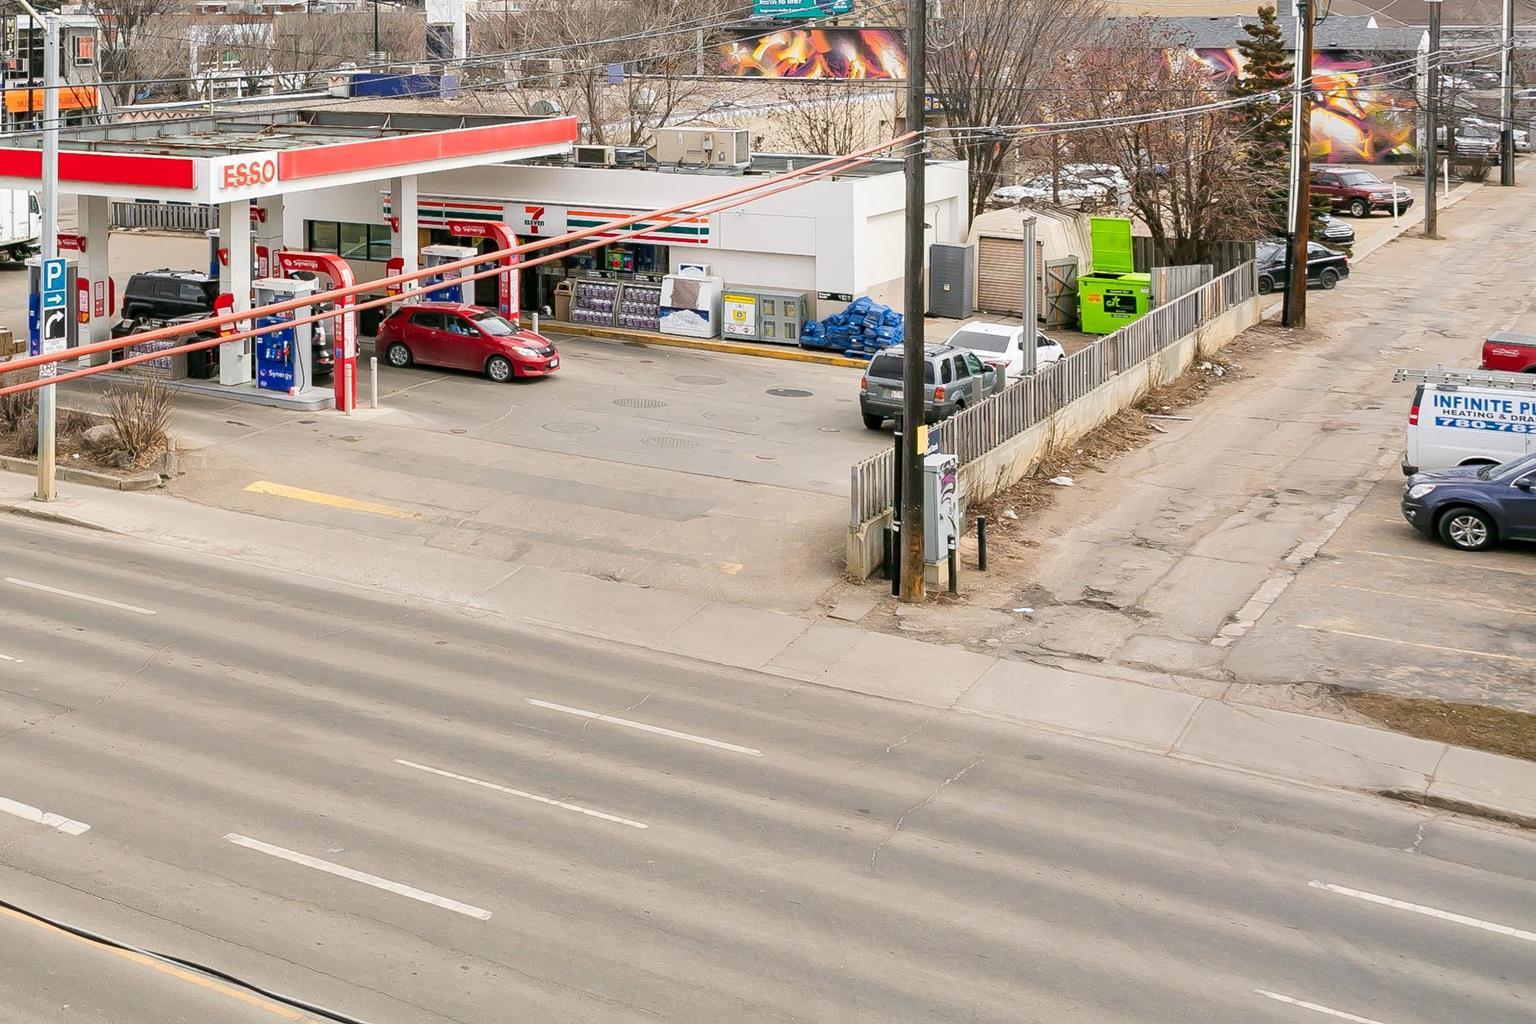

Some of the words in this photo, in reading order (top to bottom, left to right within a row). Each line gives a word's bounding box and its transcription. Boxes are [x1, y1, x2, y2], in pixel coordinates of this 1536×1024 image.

[6, 18, 14, 58] MUSIC
[223, 159, 275, 189] ESSO
[461, 225, 486, 234] Synergy
[524, 206, 545, 234] 7
[293, 259, 318, 269] Synergy
[48, 262, 62, 289] P
[268, 369, 293, 380] Synergy
[1433, 394, 1513, 414] INFINITE
[1442, 409, 1494, 419] HEATING
